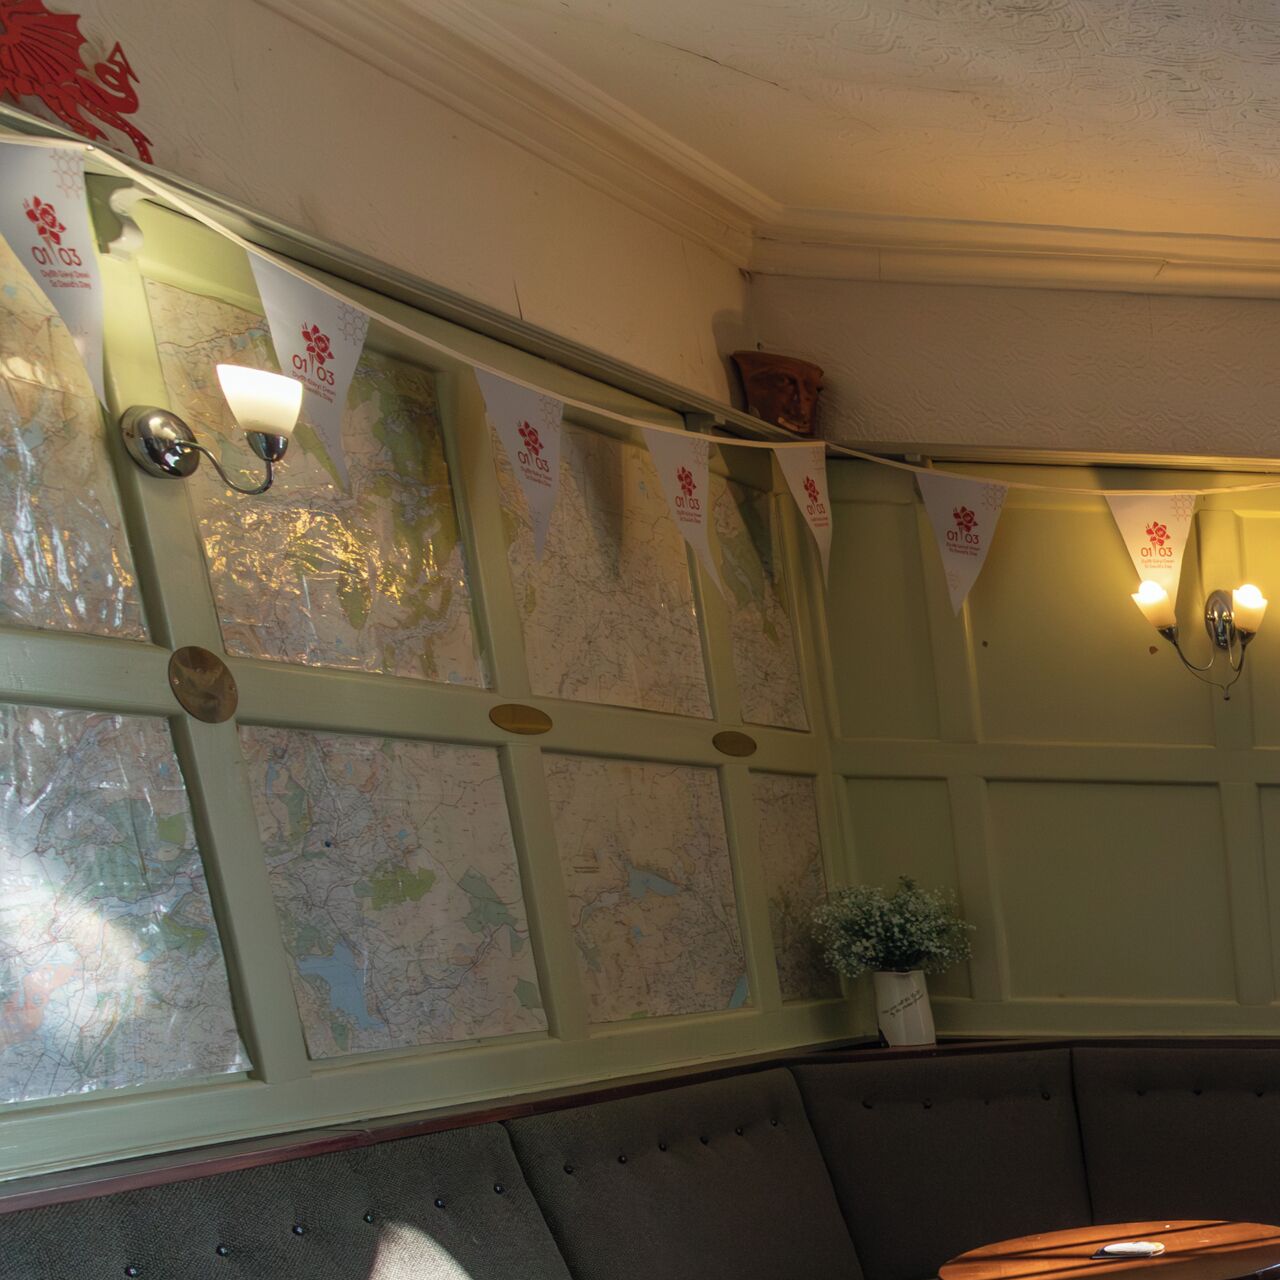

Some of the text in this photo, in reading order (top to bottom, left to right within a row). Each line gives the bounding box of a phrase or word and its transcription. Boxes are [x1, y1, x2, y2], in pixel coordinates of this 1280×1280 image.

[31, 246, 82, 266] 01 03
[292, 354, 335, 386] 01 03
[518, 451, 550, 473] 01 03
[946, 530, 980, 545] 01 03
[1140, 547, 1173, 557] 01 03
